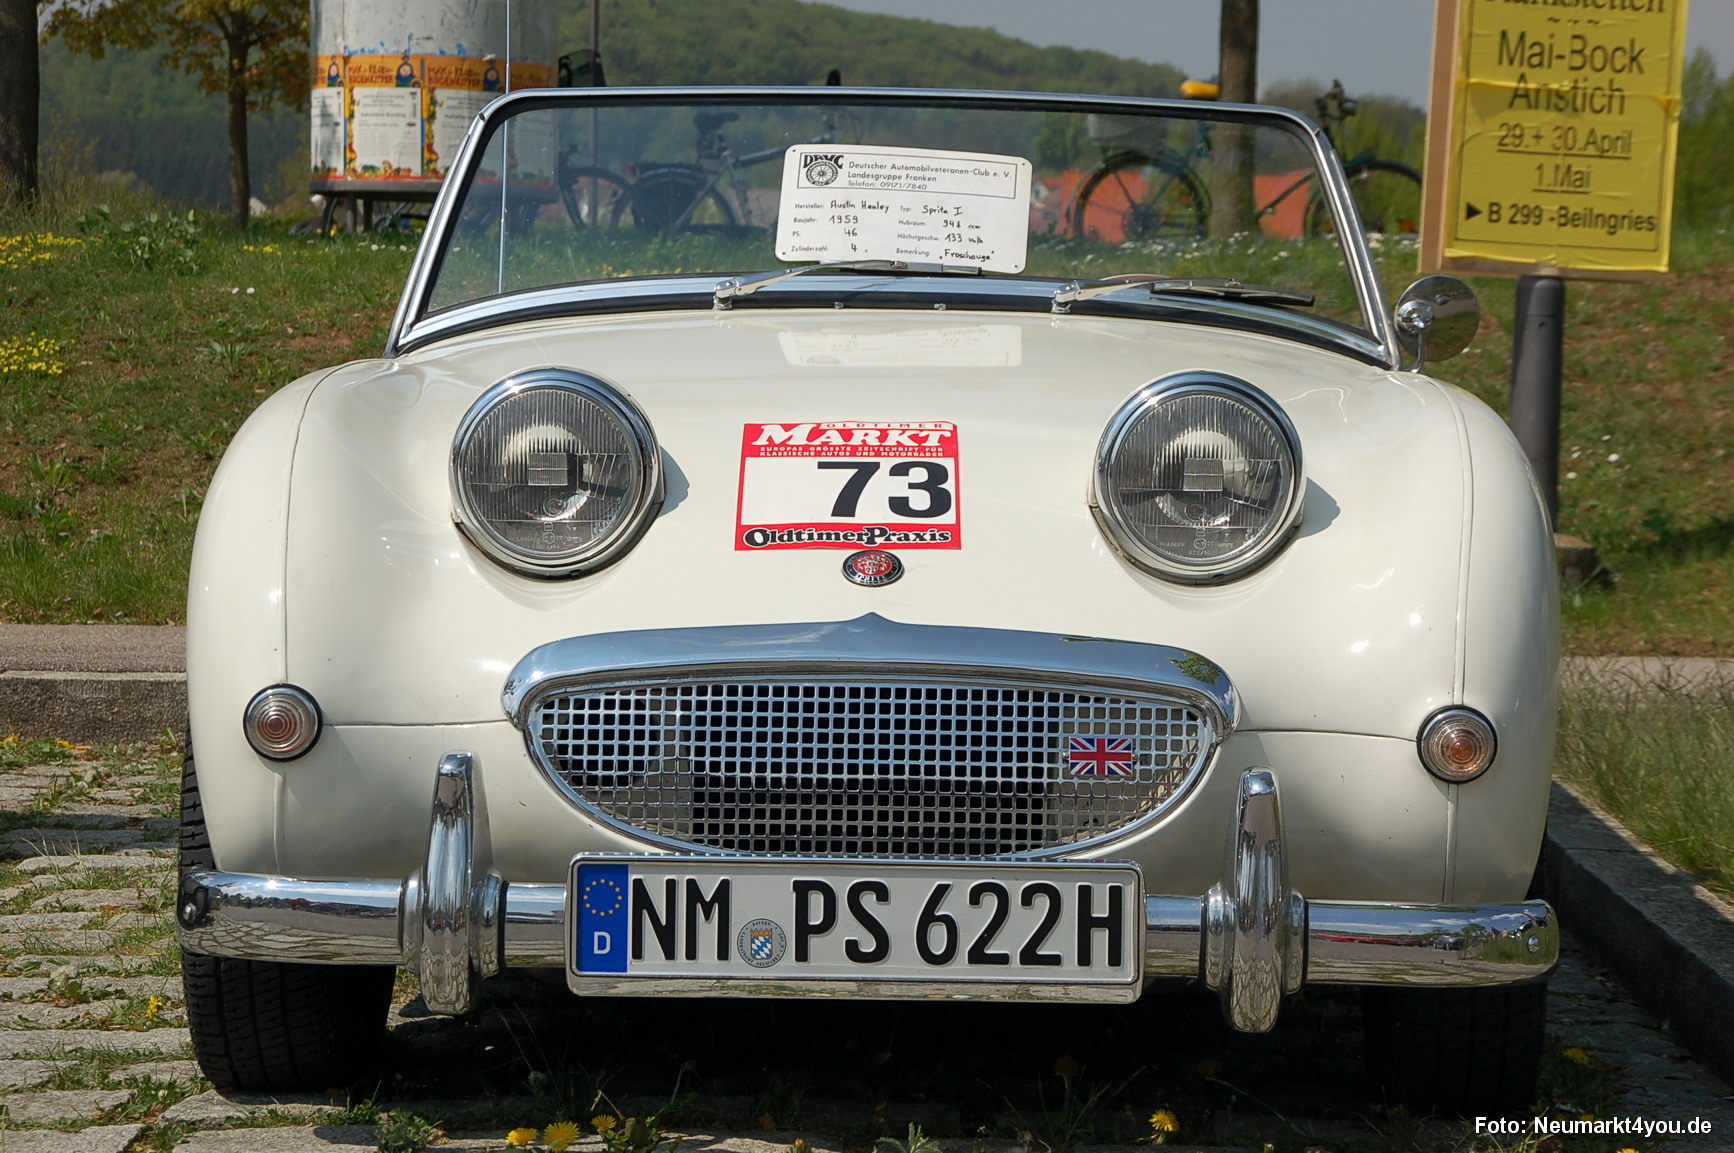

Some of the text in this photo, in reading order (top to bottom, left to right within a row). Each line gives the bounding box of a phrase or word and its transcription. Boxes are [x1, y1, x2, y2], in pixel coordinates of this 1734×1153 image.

[1497, 29, 1646, 75] Mai-Bock
[1508, 72, 1627, 116] Anstich
[847, 171, 937, 182] Landesgruppe Franken
[848, 161, 887, 170] Deutscher
[890, 163, 990, 177] Automobilveteranen-Club
[880, 181, 928, 190] 09171/7840
[830, 200, 890, 213] Austin Healey
[922, 205, 949, 215] Sprite
[1488, 202, 1502, 223] B
[1508, 202, 1543, 226] 299
[829, 214, 859, 224] 1959
[844, 227, 858, 237] 46
[944, 233, 963, 243] 133
[850, 242, 859, 253] 4
[751, 424, 952, 447] MARKT
[817, 461, 952, 518] 73
[745, 526, 952, 547] OldtimerPraxis
[630, 877, 1124, 967] NM PS 622H
[593, 934, 611, 955] D
